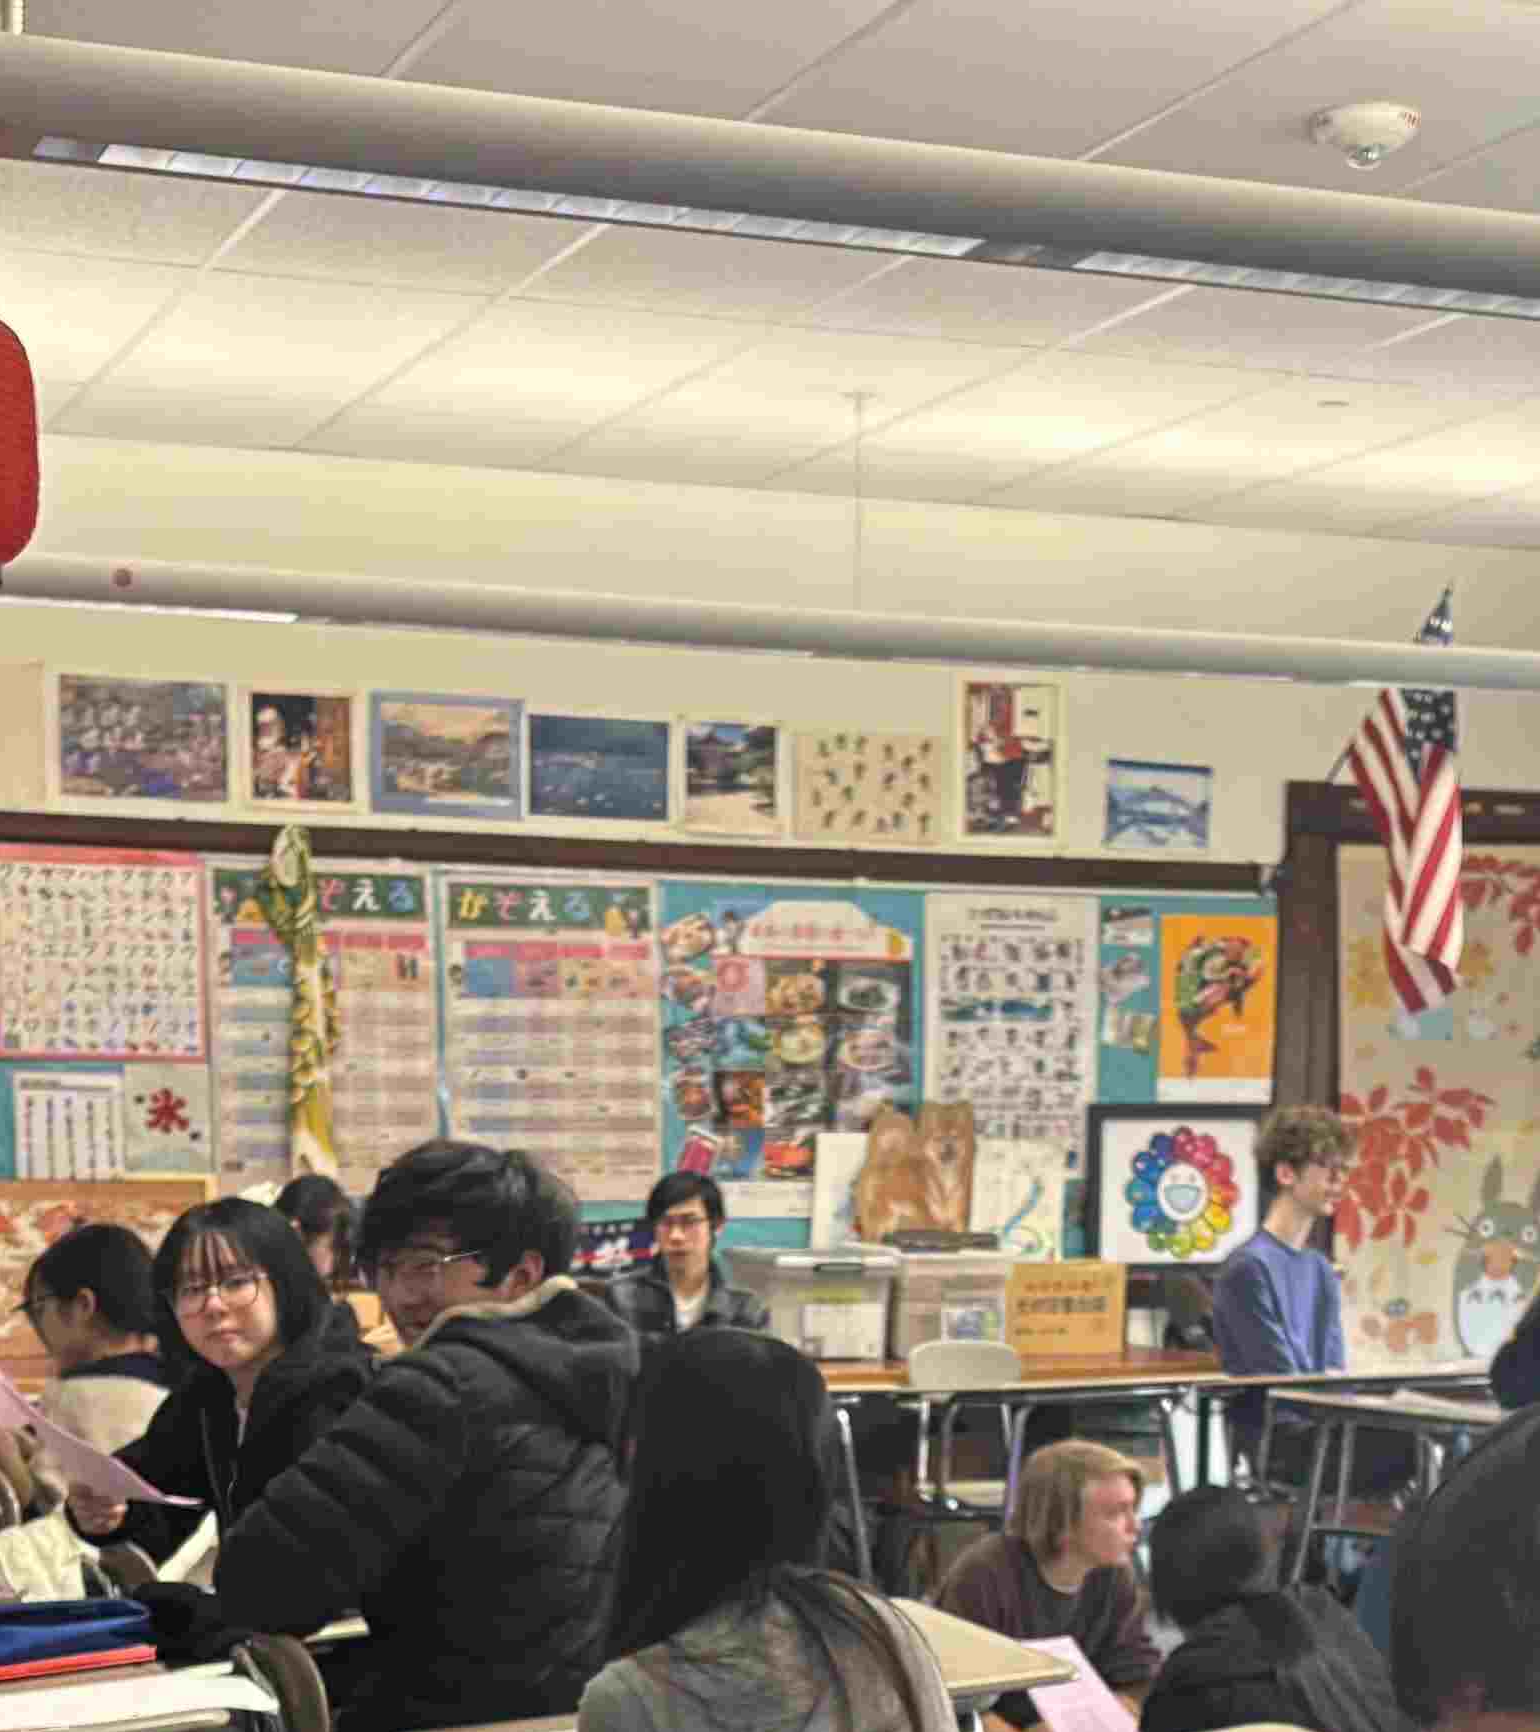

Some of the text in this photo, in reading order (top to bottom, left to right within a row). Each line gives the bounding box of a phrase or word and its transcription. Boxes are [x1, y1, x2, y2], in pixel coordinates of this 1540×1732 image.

[317, 876, 416, 914] ぞえる
[456, 890, 591, 922] かぞえる
